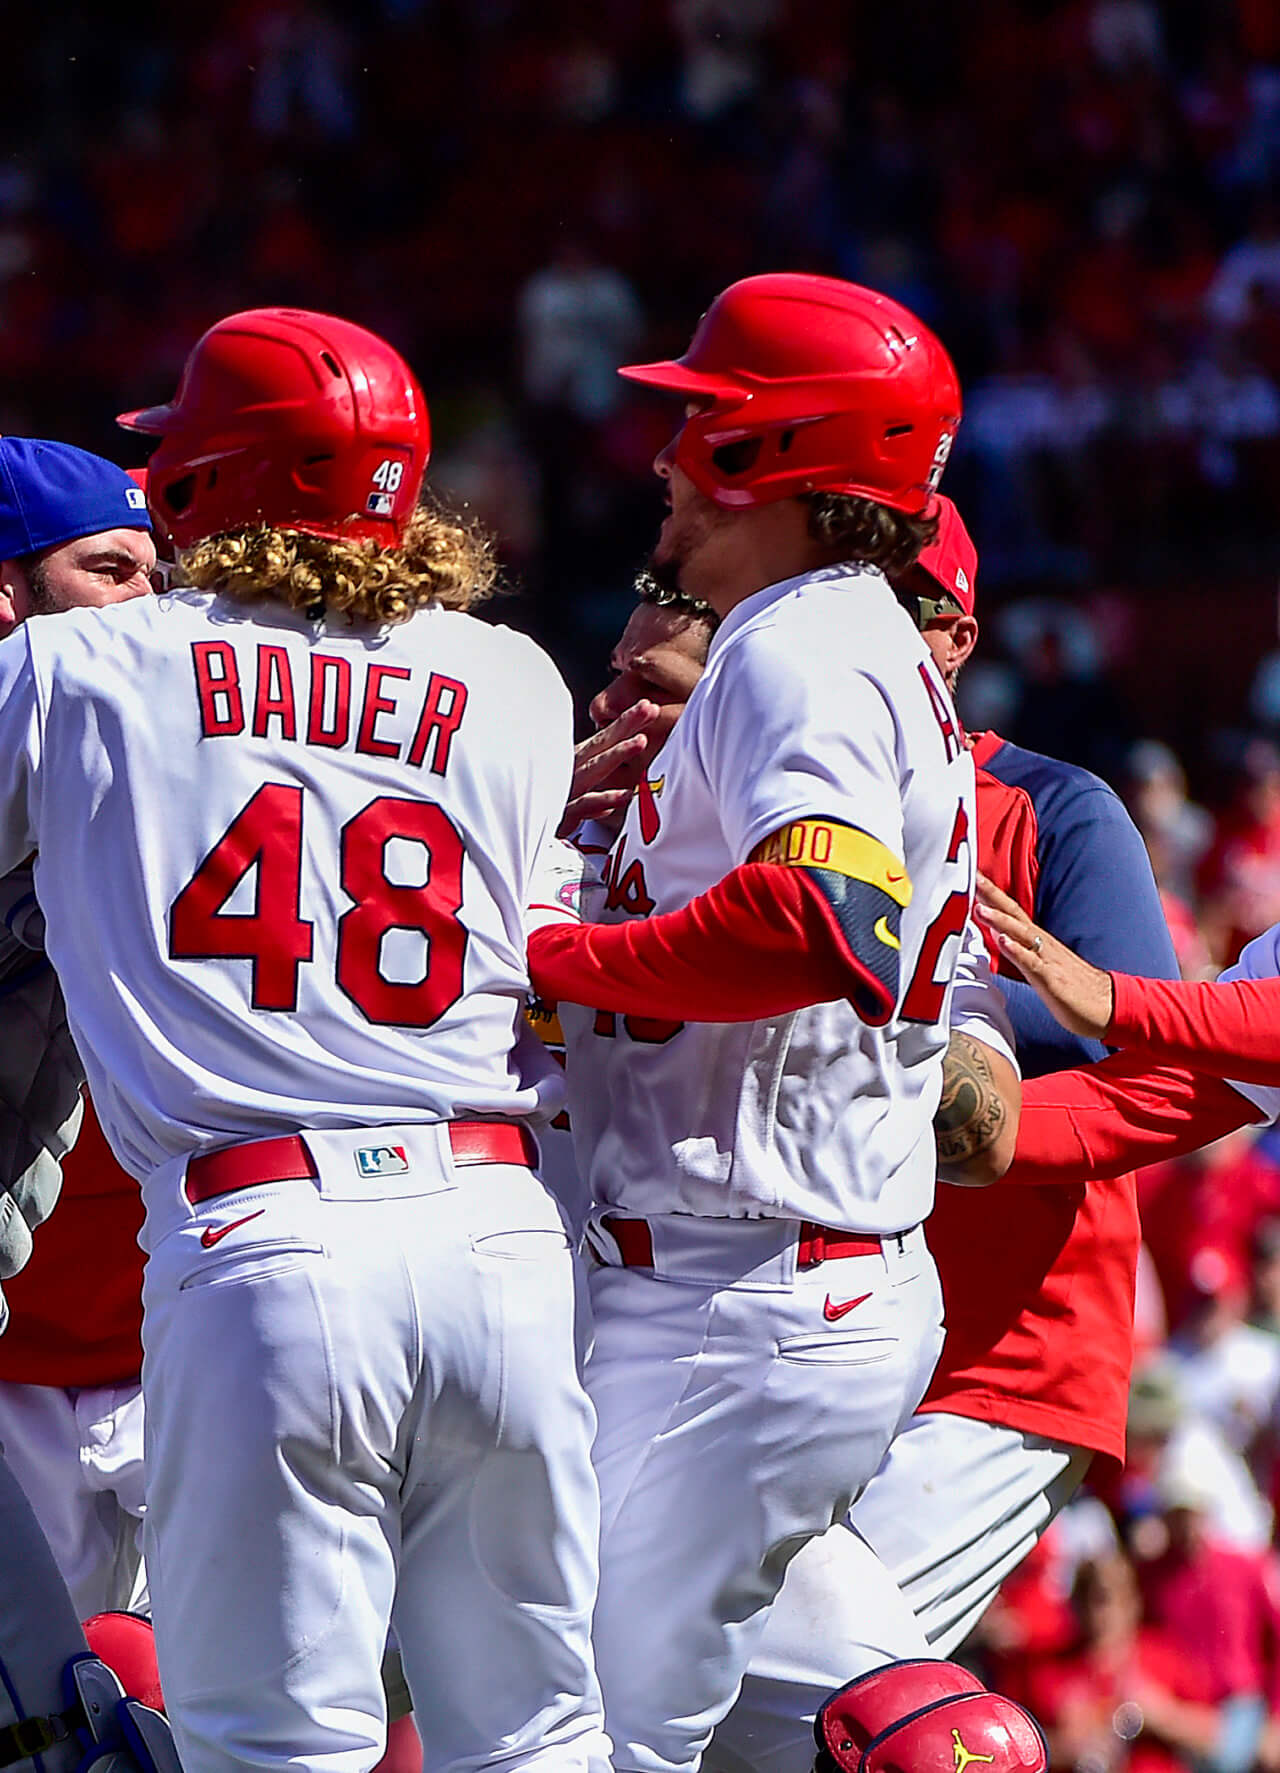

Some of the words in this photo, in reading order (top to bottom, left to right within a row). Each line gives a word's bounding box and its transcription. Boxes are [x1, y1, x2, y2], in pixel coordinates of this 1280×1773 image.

[372, 460, 404, 493] 48
[190, 640, 469, 778] BADER
[168, 781, 470, 1030] 48
